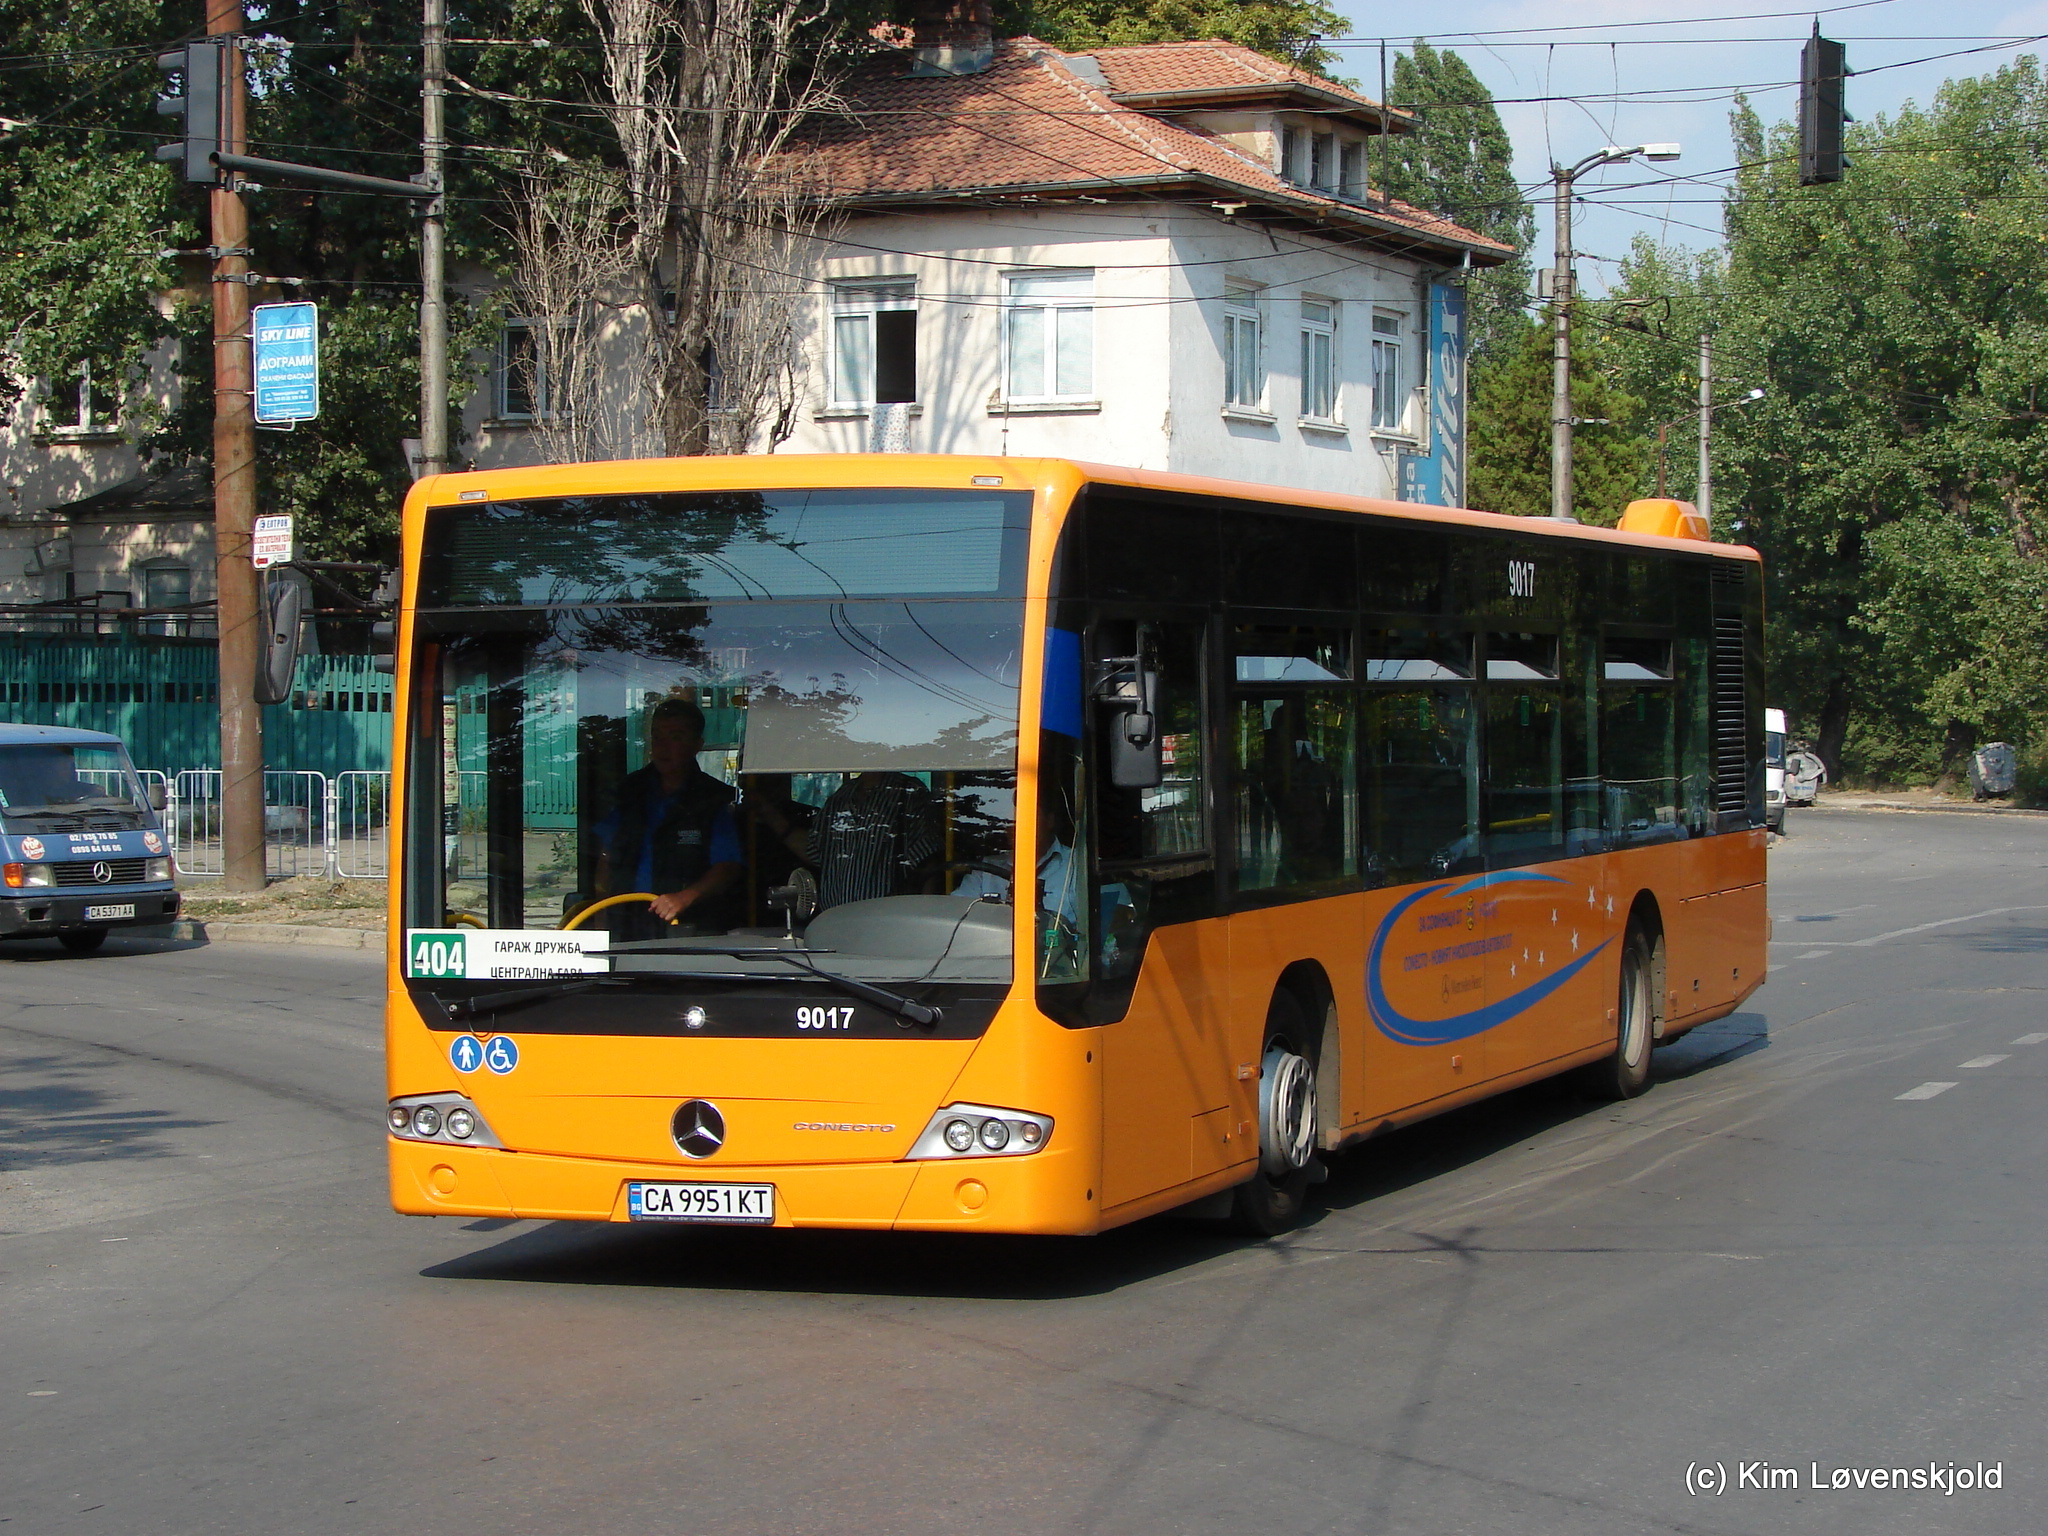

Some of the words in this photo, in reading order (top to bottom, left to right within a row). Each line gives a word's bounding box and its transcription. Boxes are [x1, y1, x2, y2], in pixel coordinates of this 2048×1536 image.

[261, 329, 283, 342] SKY
[285, 327, 312, 340] LINE
[260, 354, 314, 371] ДОГРАМИ
[1509, 560, 1535, 597] 9017
[495, 941, 531, 953] ГАРАЖ
[534, 942, 581, 955] ДРУЖБА
[415, 941, 464, 976] 404
[491, 966, 553, 979] ЦЕНТРАЛНА
[797, 1006, 855, 1029] 9017
[793, 1121, 896, 1133] CONECTO
[631, 1203, 641, 1211] BG
